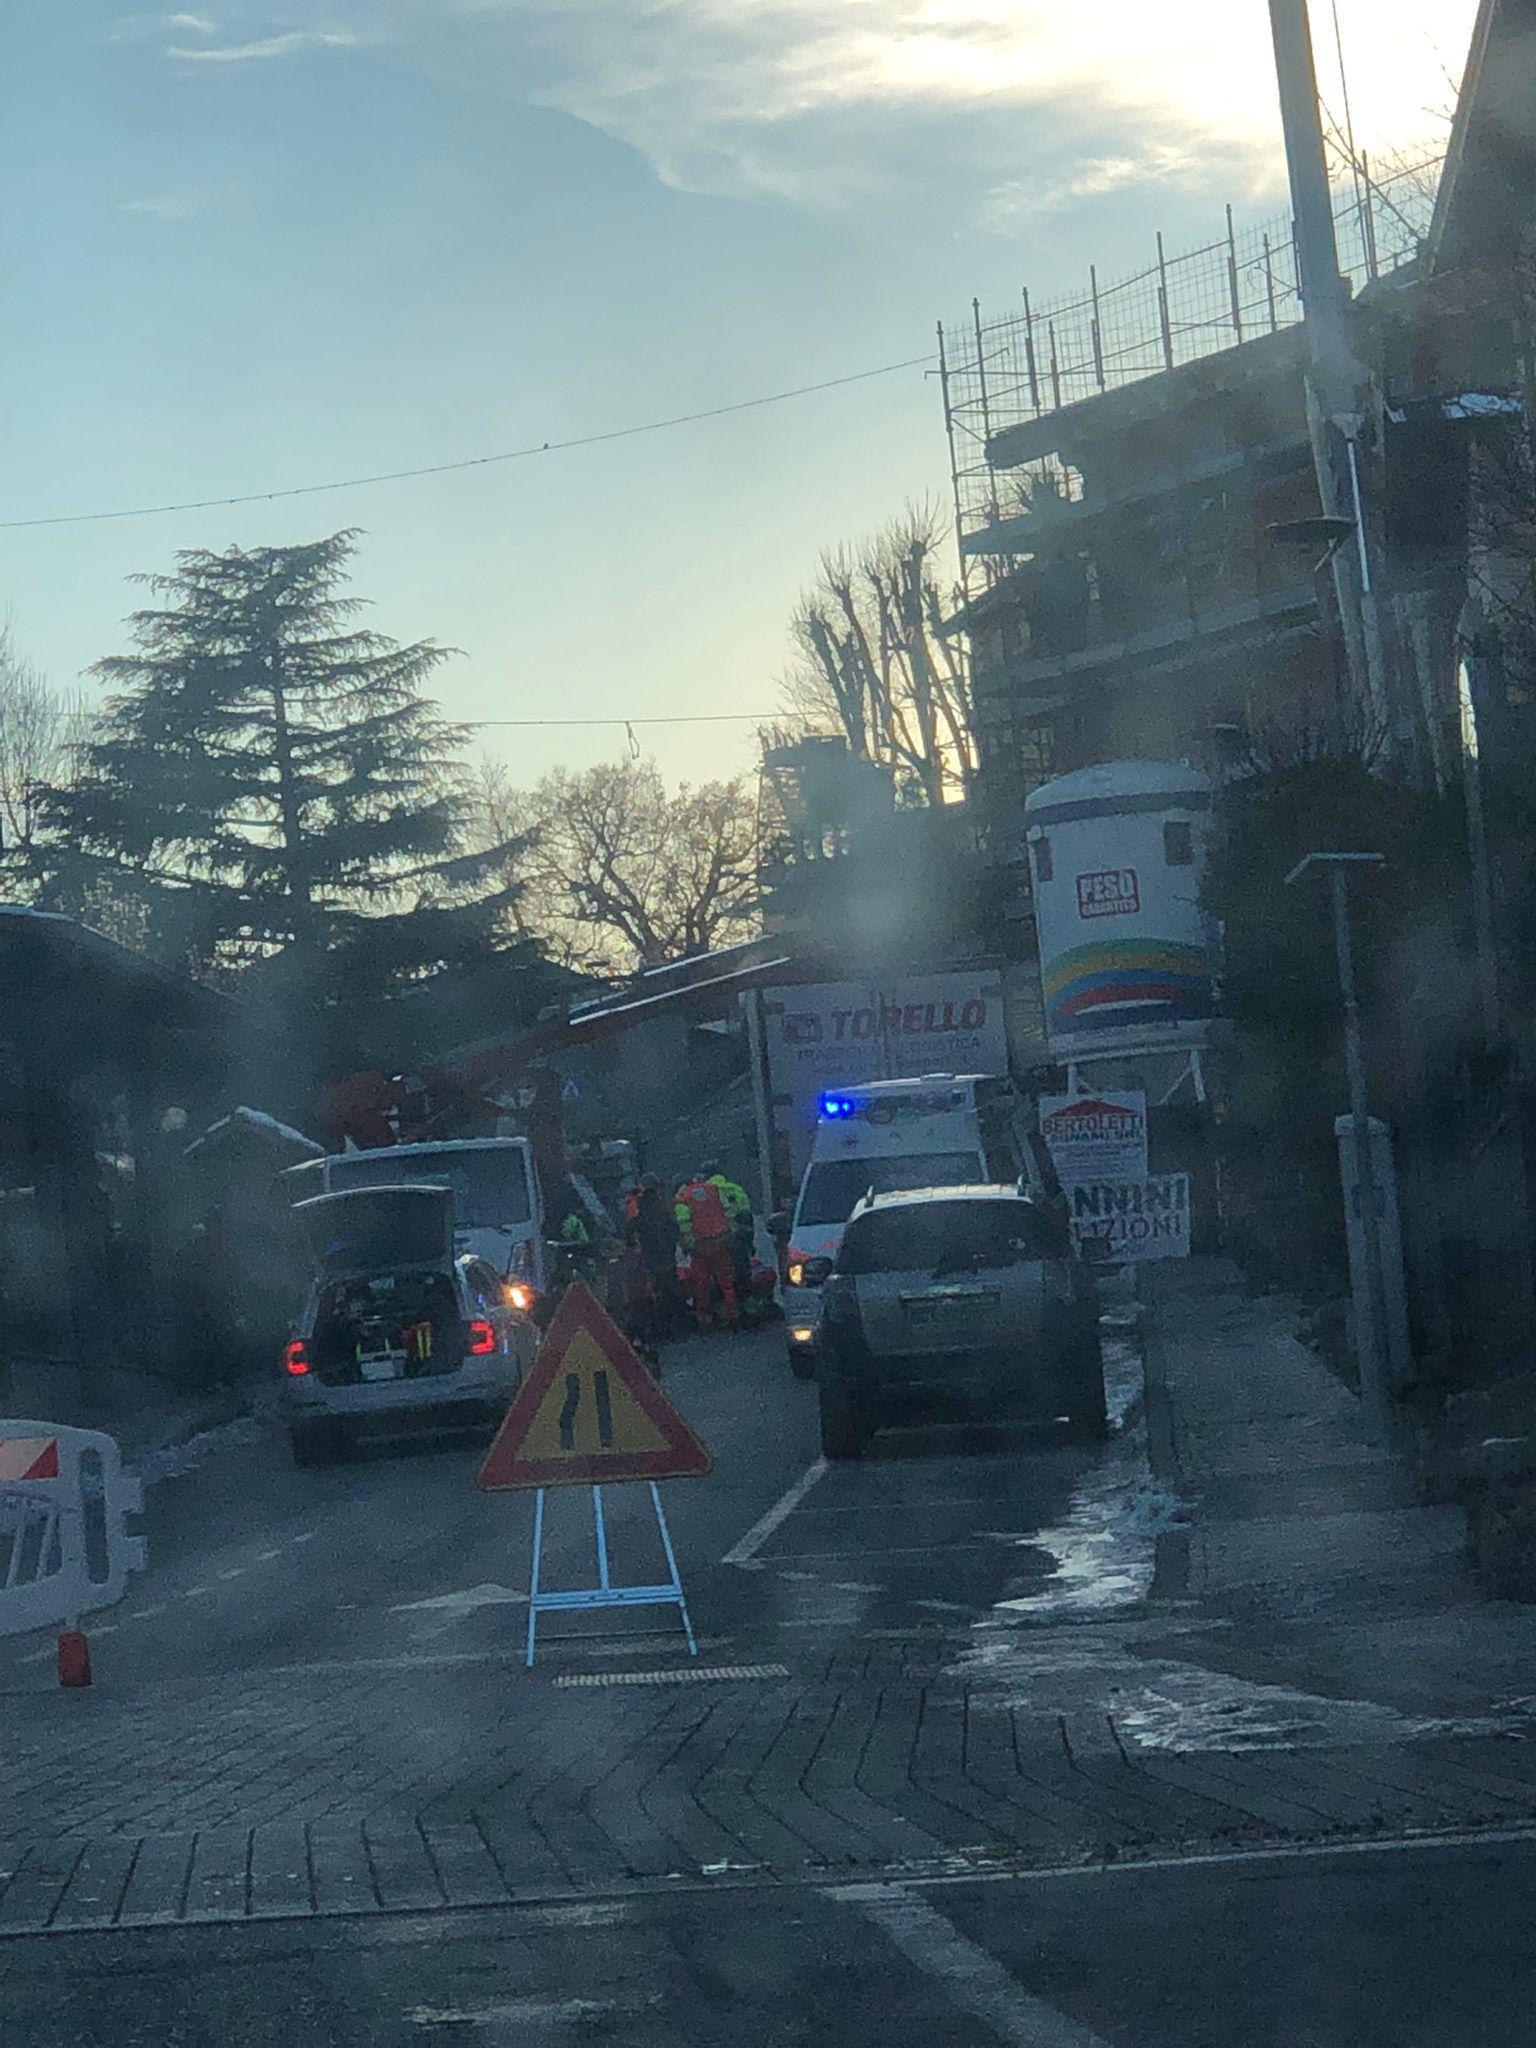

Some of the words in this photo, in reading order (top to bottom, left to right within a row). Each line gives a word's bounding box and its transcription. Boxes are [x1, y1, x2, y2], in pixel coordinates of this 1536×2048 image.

[1080, 872, 1134, 901] PESO
[831, 998, 987, 1040] TORELLO
[1042, 1114, 1144, 1135] BERTOLETTI
